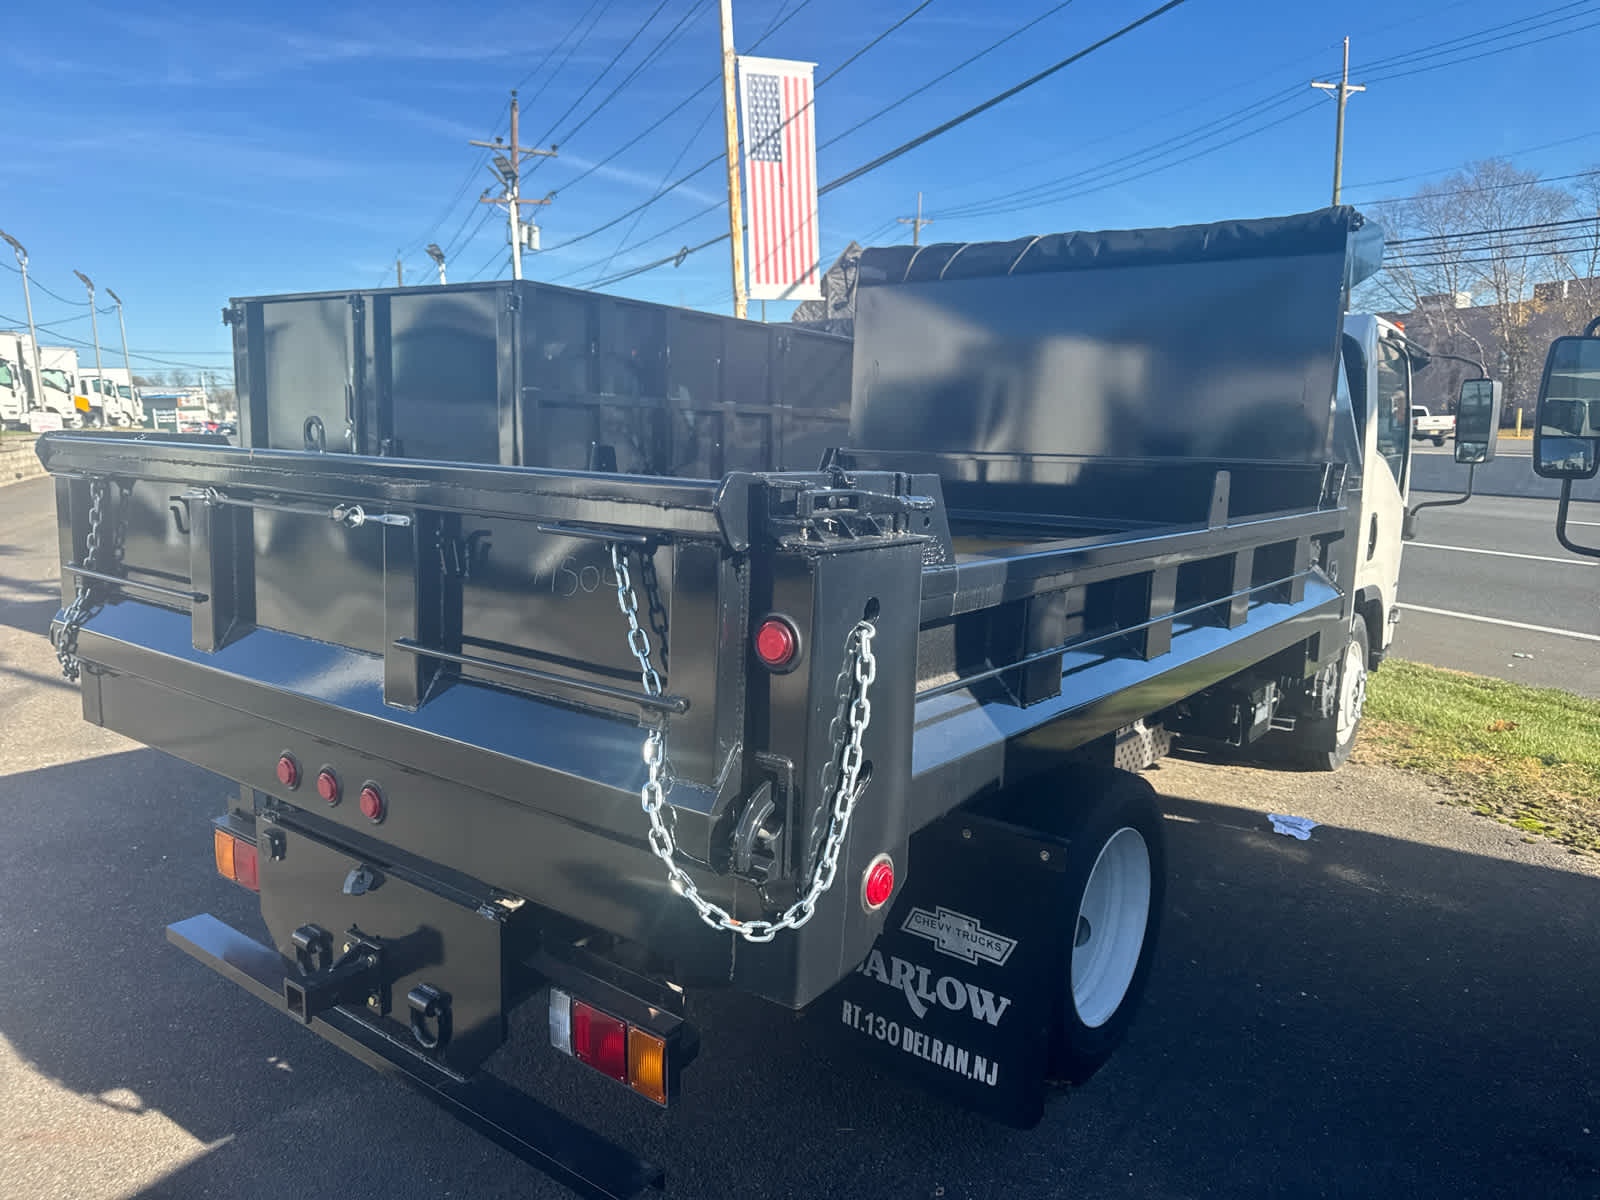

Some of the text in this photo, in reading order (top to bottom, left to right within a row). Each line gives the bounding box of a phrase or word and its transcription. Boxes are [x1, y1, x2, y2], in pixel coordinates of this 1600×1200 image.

[914, 914, 1002, 952] CHEVY TRUCKS
[856, 949, 1011, 1027] ARLOW
